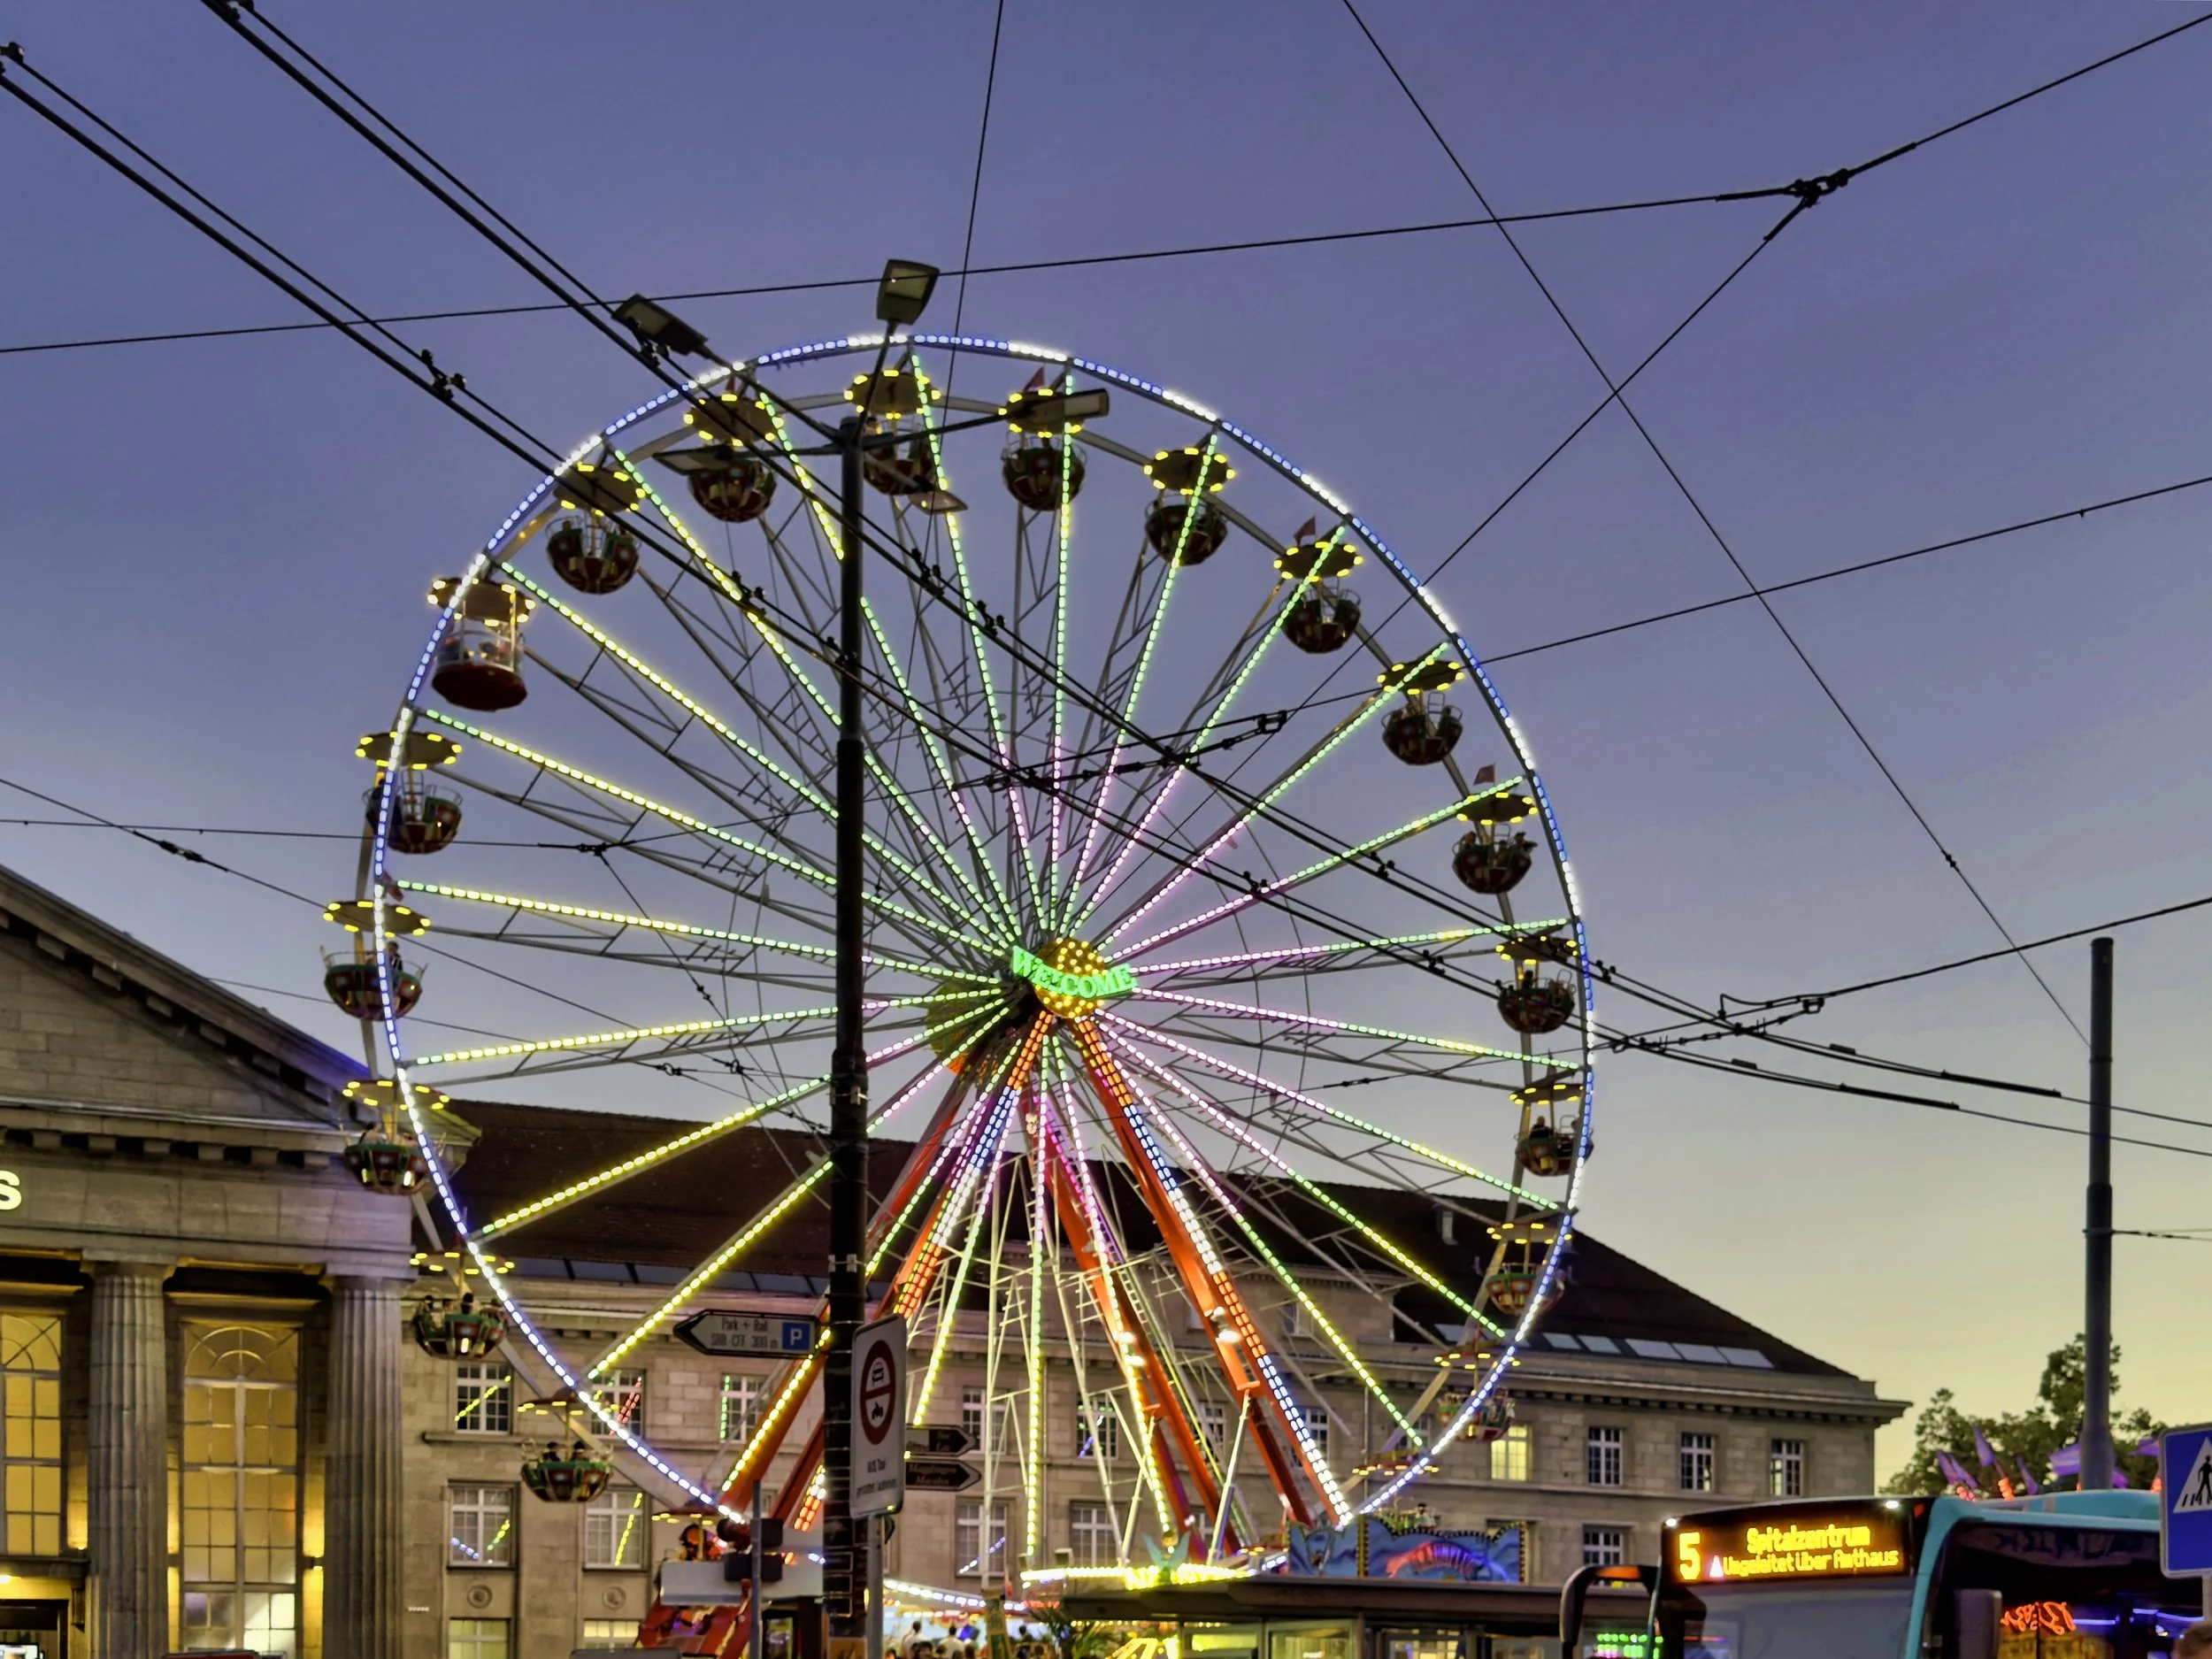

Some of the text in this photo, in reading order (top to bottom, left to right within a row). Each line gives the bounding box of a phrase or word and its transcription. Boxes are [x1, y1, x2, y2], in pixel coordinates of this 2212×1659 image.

[1010, 945, 1139, 999] WELCOME
[789, 1328, 803, 1346] P
[1678, 1532, 1700, 1580] 5
[1747, 1524, 1870, 1555] Spitalzentrum
